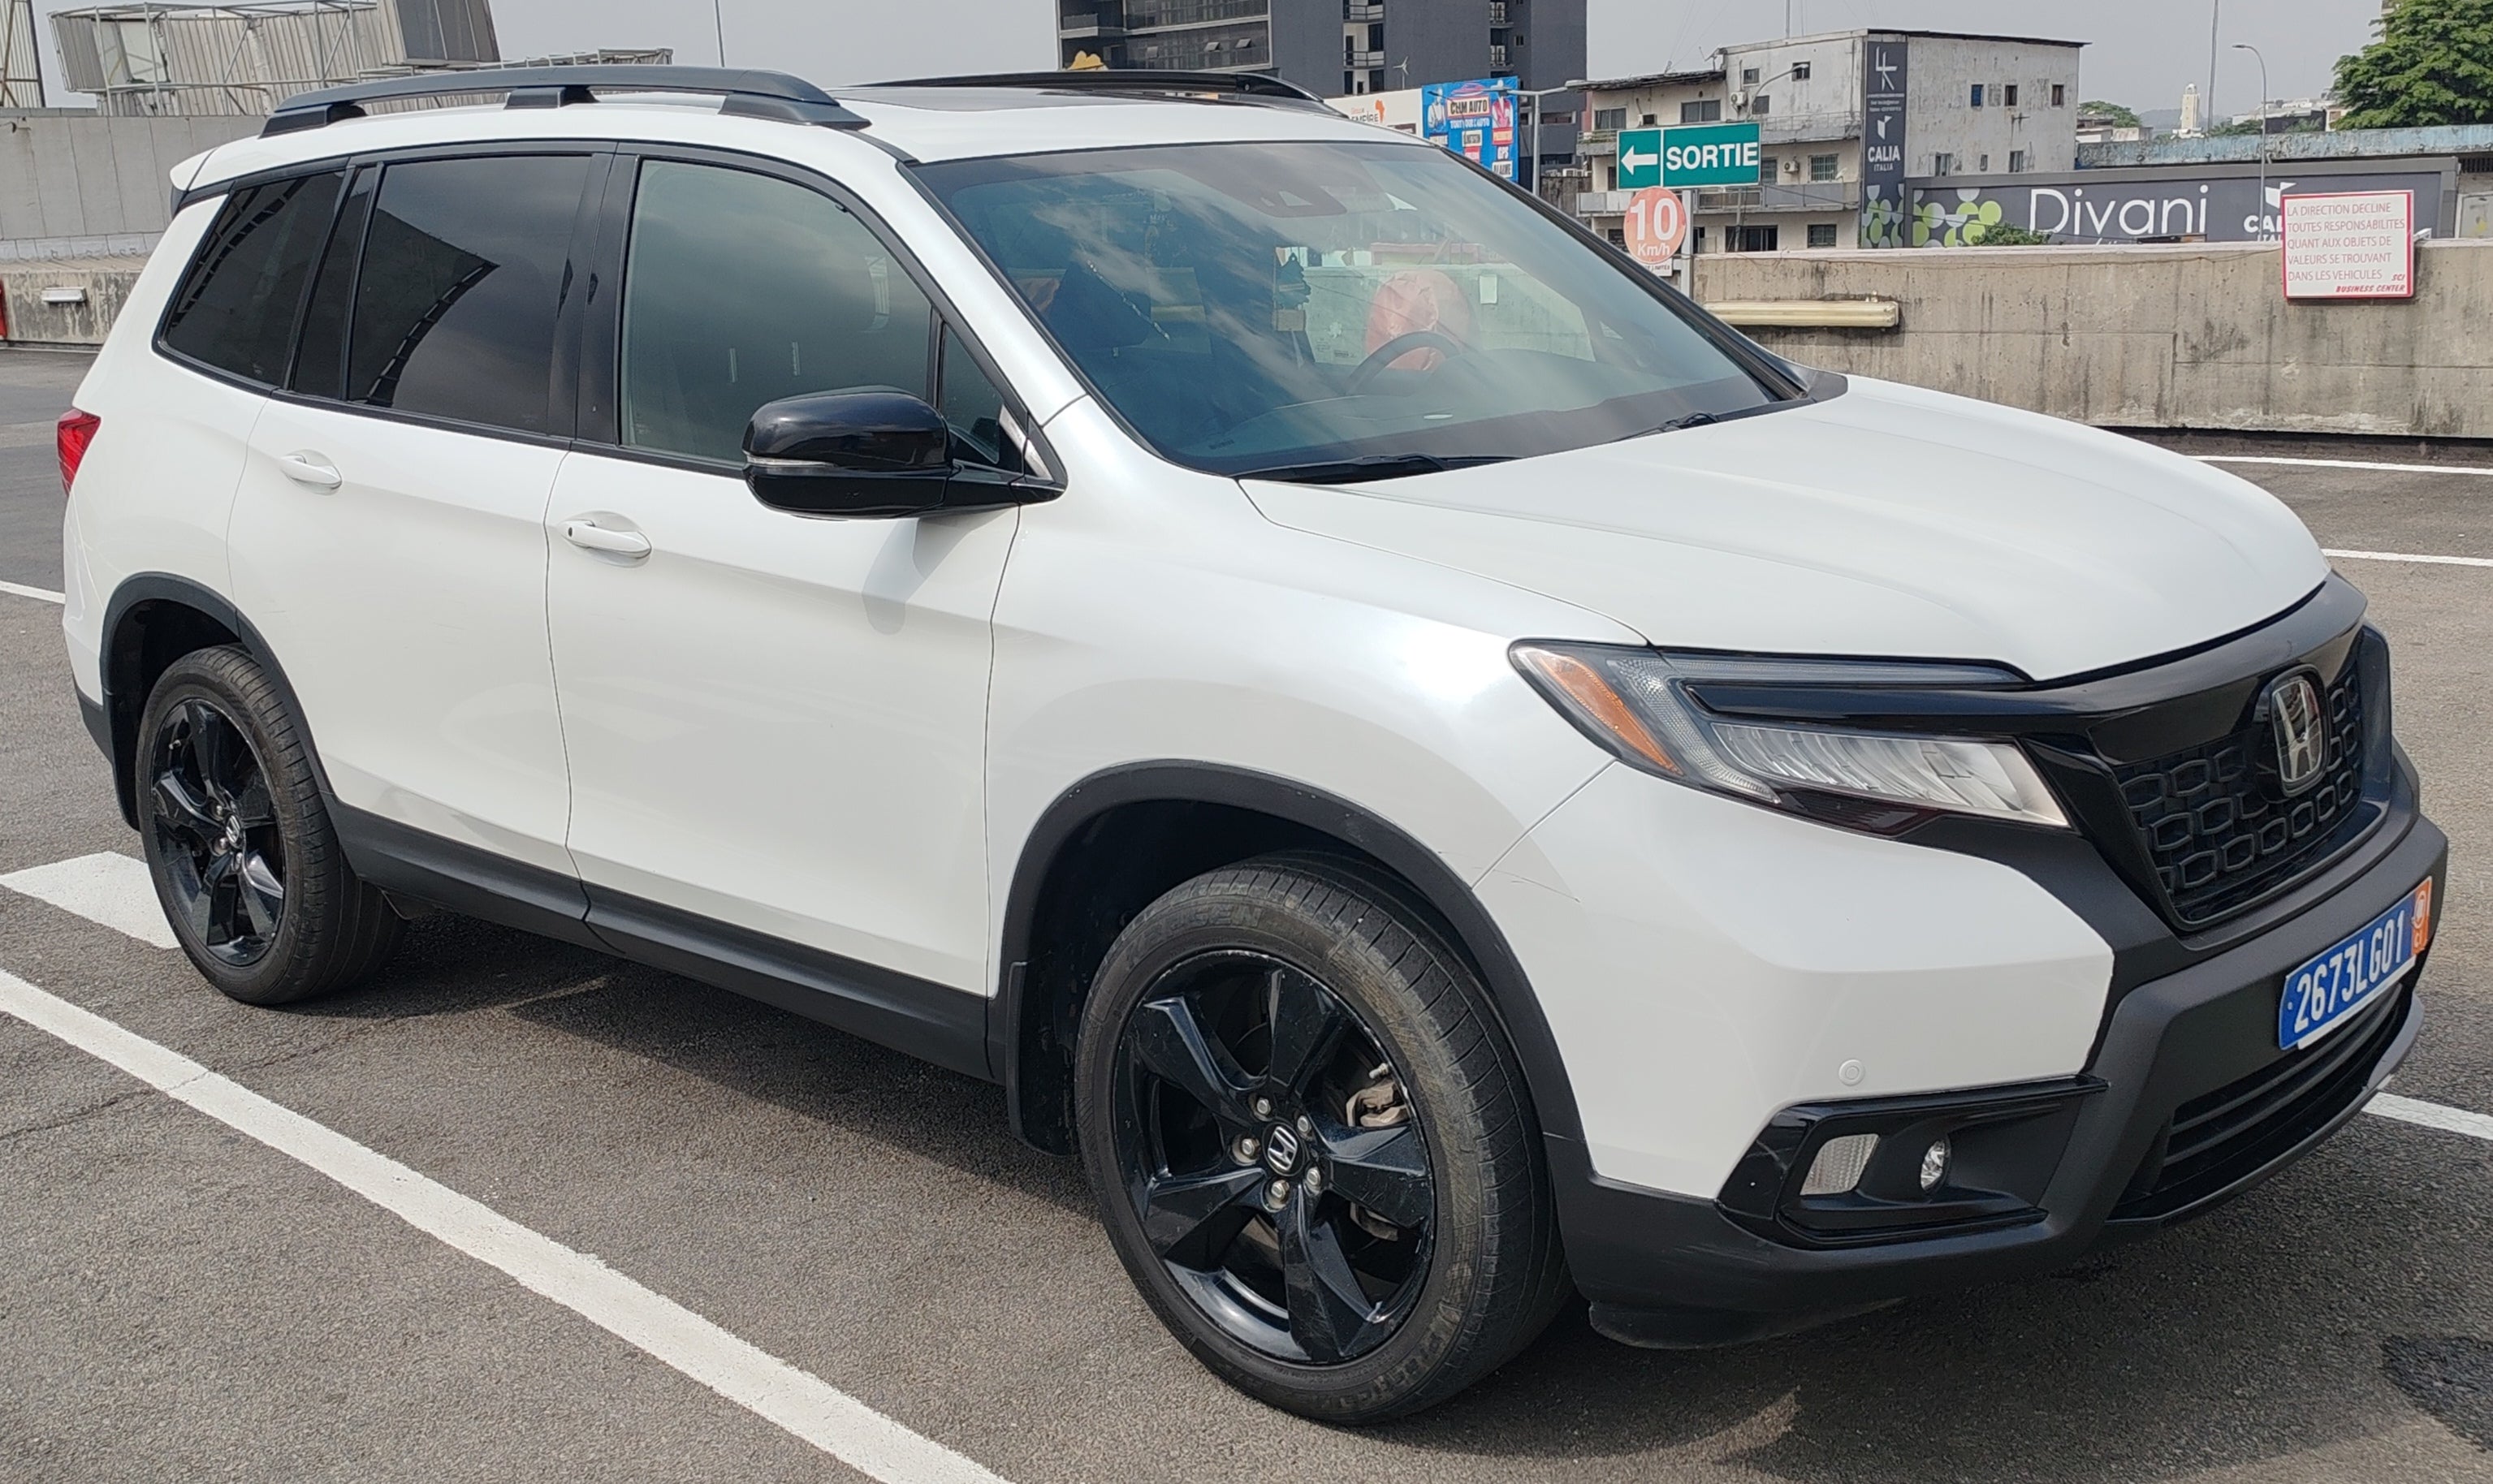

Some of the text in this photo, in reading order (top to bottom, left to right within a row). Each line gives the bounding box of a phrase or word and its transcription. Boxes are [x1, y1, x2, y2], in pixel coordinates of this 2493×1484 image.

[1469, 99, 1488, 113] AUTO
[1666, 142, 1758, 170] SORTIE
[1868, 145, 1900, 162] CALIA
[1874, 163, 1894, 171] ITALIA
[2029, 184, 2209, 235] Divani
[2287, 202, 2391, 217] LA DIRECTION DECLINE
[1630, 197, 1679, 241] 10
[2288, 218, 2405, 233] TOUTES RESPONSABILITES
[1637, 243, 1670, 257] Km/h
[2288, 235, 2391, 250] QUANT AUX OBJETS DE
[2288, 252, 2392, 265] VALEURS SE TROUVANT
[2288, 269, 2383, 282] DANS LES VEHICULES
[2391, 274, 2405, 282] SCI
[2335, 284, 2405, 293] BUSINESS CENTER
[2294, 909, 2404, 1033] 2673LG01
